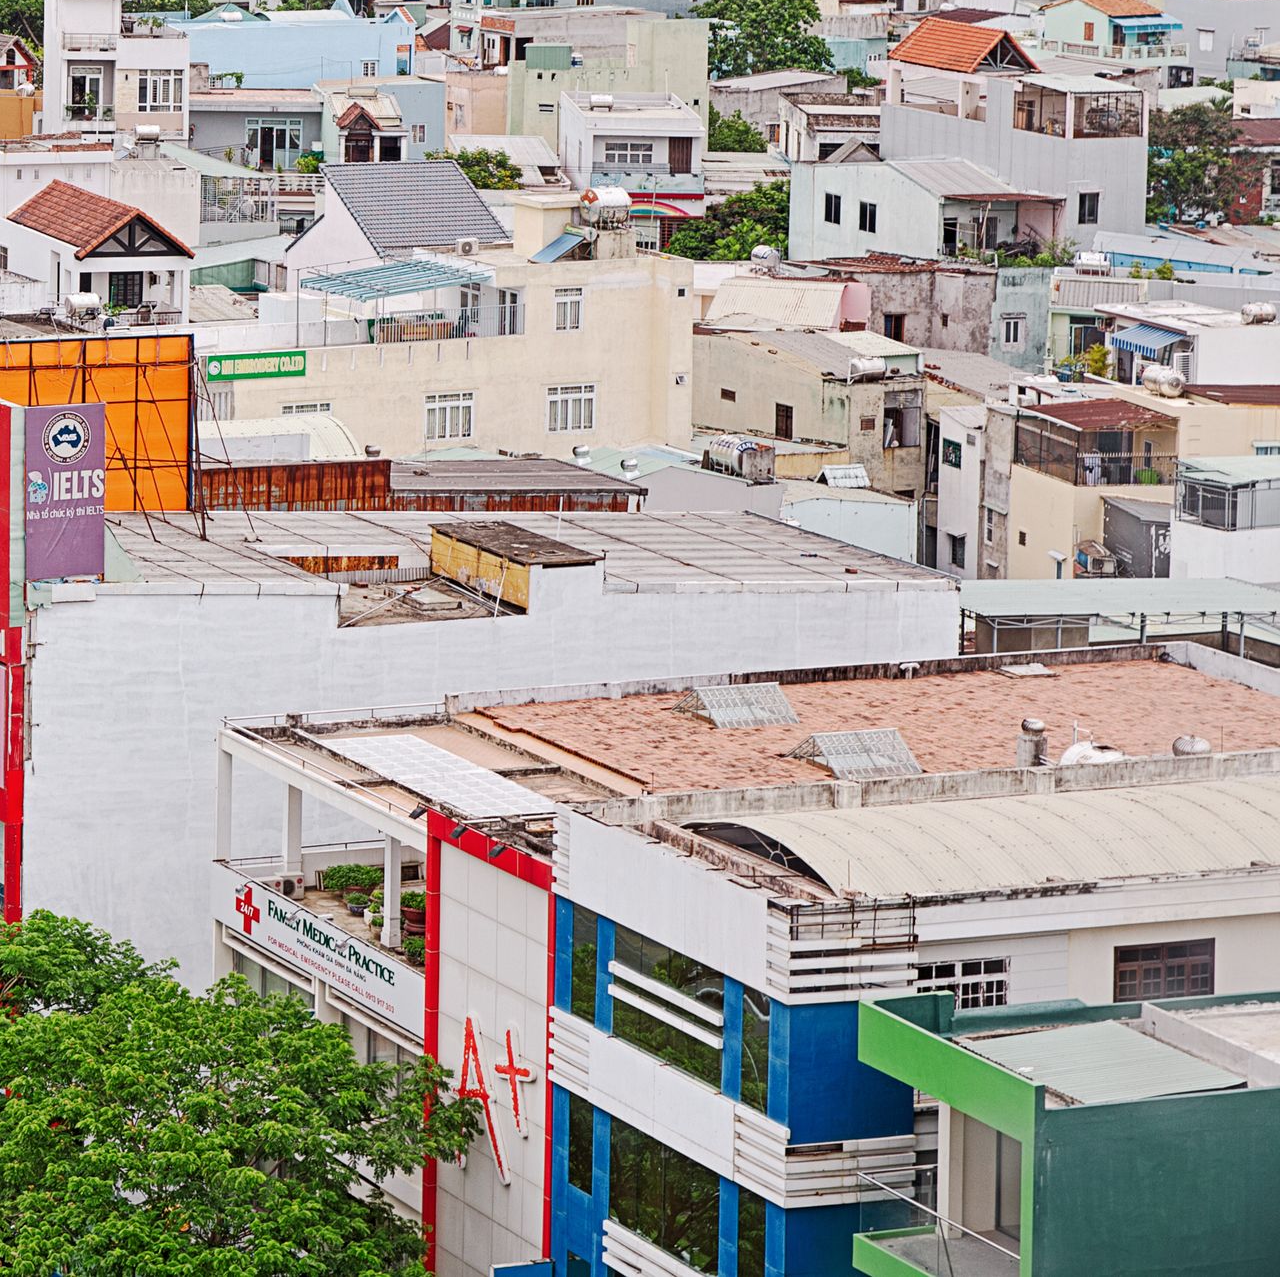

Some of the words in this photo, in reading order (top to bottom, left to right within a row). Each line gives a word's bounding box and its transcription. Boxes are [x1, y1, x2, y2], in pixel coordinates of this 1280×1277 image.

[53, 468, 104, 501] IELTS
[27, 510, 40, 521] Nhà
[50, 508, 66, 519] chức
[76, 506, 86, 517] thi
[86, 505, 104, 516] IELTS
[240, 901, 254, 917] 24/7
[268, 935, 277, 946] FOR
[277, 940, 299, 959] MEDICAL
[300, 954, 332, 978] EMERGENCY
[332, 972, 351, 989] PLEASE
[352, 981, 364, 997] CALL
[348, 944, 395, 987] PRACTICE
